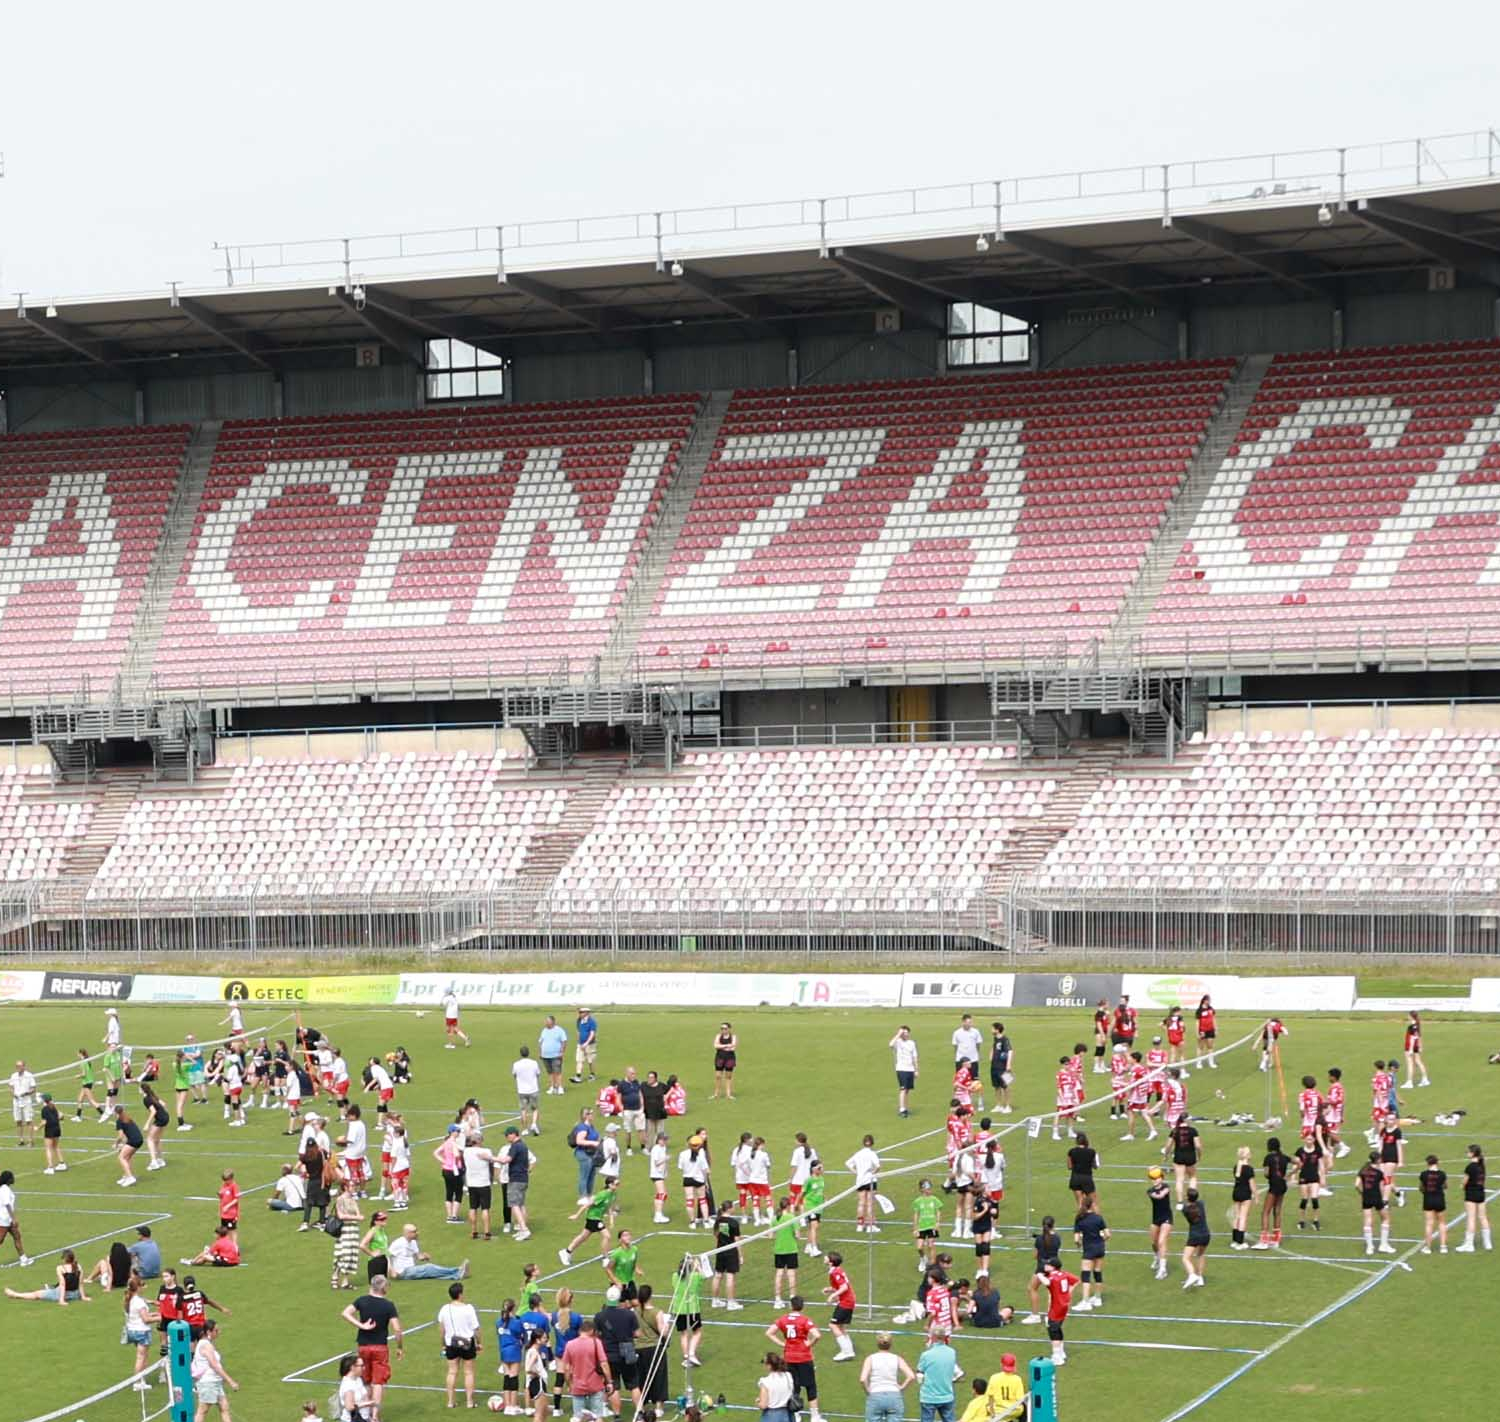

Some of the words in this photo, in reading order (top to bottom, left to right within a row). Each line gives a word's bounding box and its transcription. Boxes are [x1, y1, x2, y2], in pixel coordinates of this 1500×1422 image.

[50, 978, 122, 996] REFURBY
[254, 988, 304, 1000] GETEC
[1046, 998, 1087, 1006] BOSELLI
[187, 1300, 202, 1316] 25
